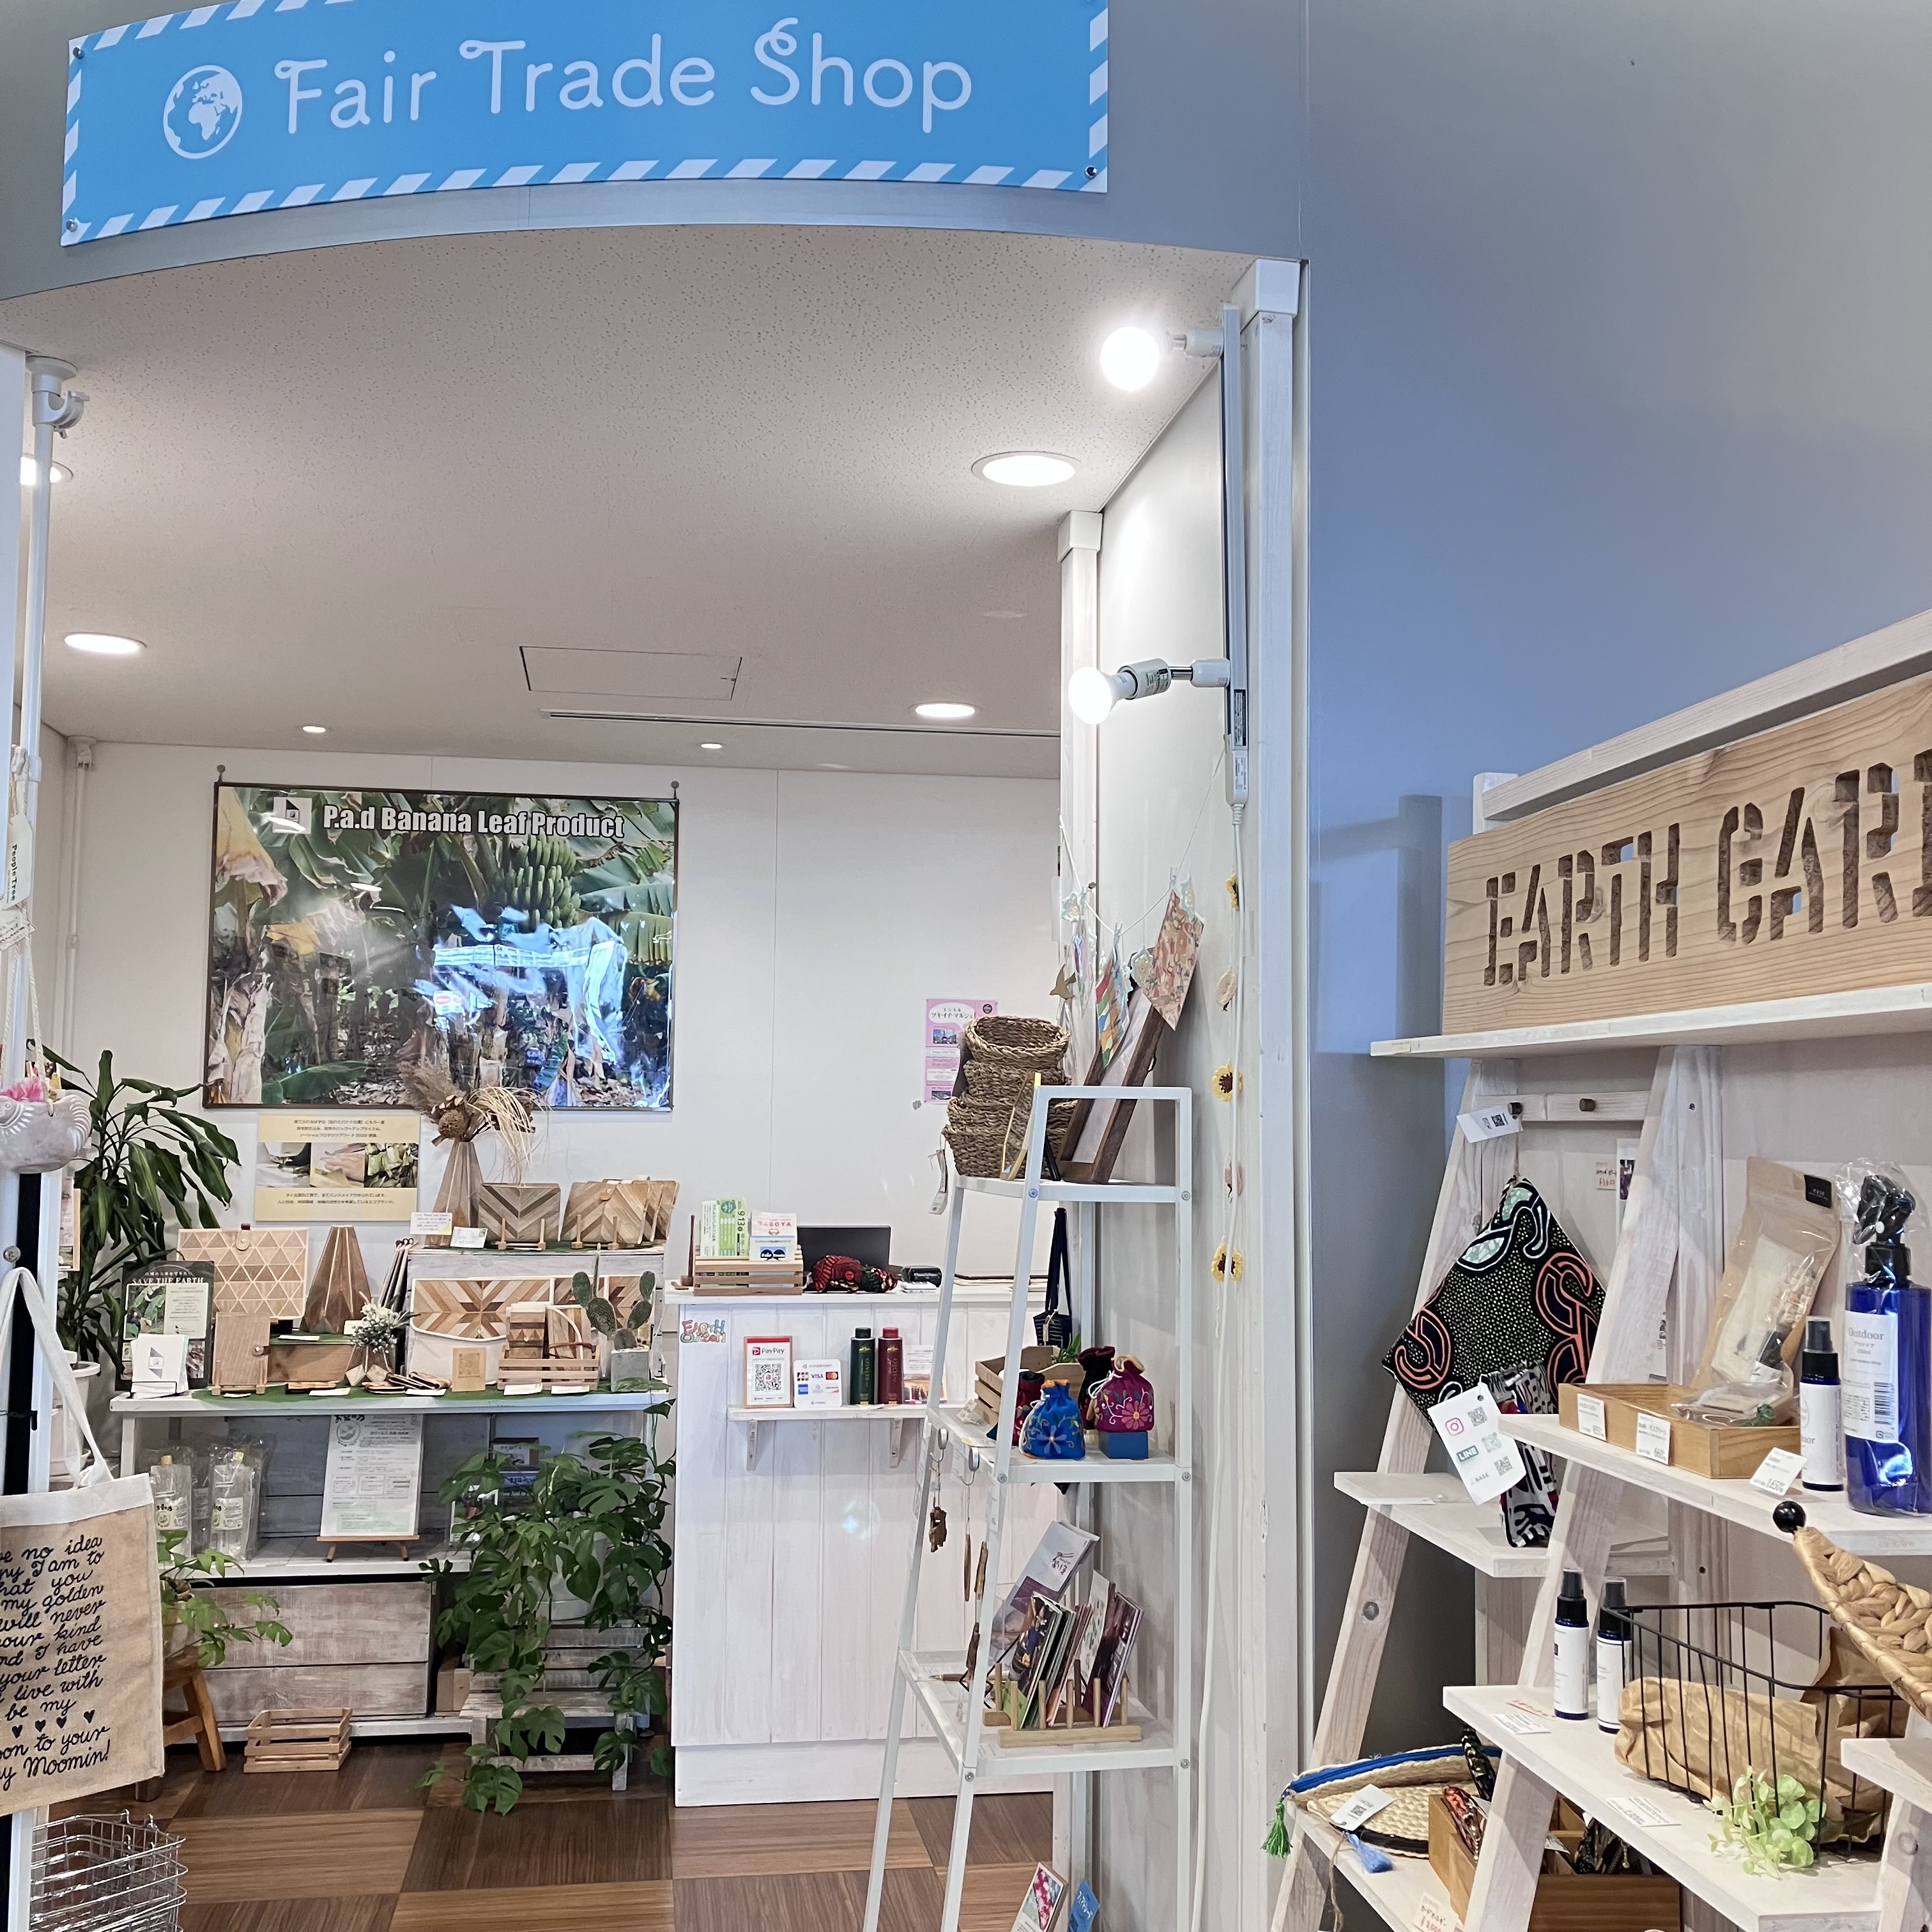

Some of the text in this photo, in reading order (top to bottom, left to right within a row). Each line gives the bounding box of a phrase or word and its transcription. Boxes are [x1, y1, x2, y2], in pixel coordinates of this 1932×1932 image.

[274, 17, 973, 134] Fair Trade Shop
[323, 804, 625, 839] P.a.d Banana Leaf Product
[1483, 822, 1681, 987] EARTH
[1848, 1327, 1885, 1340] Outdoor
[1457, 1446, 1478, 1460] LINE
[21, 1546, 54, 1560] no
[65, 1534, 103, 1555] idea
[48, 1558, 80, 1572] am
[87, 1550, 105, 1565] to
[51, 1569, 94, 1596] you
[1, 1584, 104, 1617] my golden
[50, 1599, 107, 1625] never
[54, 1615, 102, 1641] kind
[56, 1634, 103, 1656] have
[13, 1669, 103, 1701] live with
[5, 1698, 77, 1721] be my
[34, 1733, 56, 1752] to
[60, 1725, 111, 1756] your
[22, 1738, 111, 1779] Moomin!
